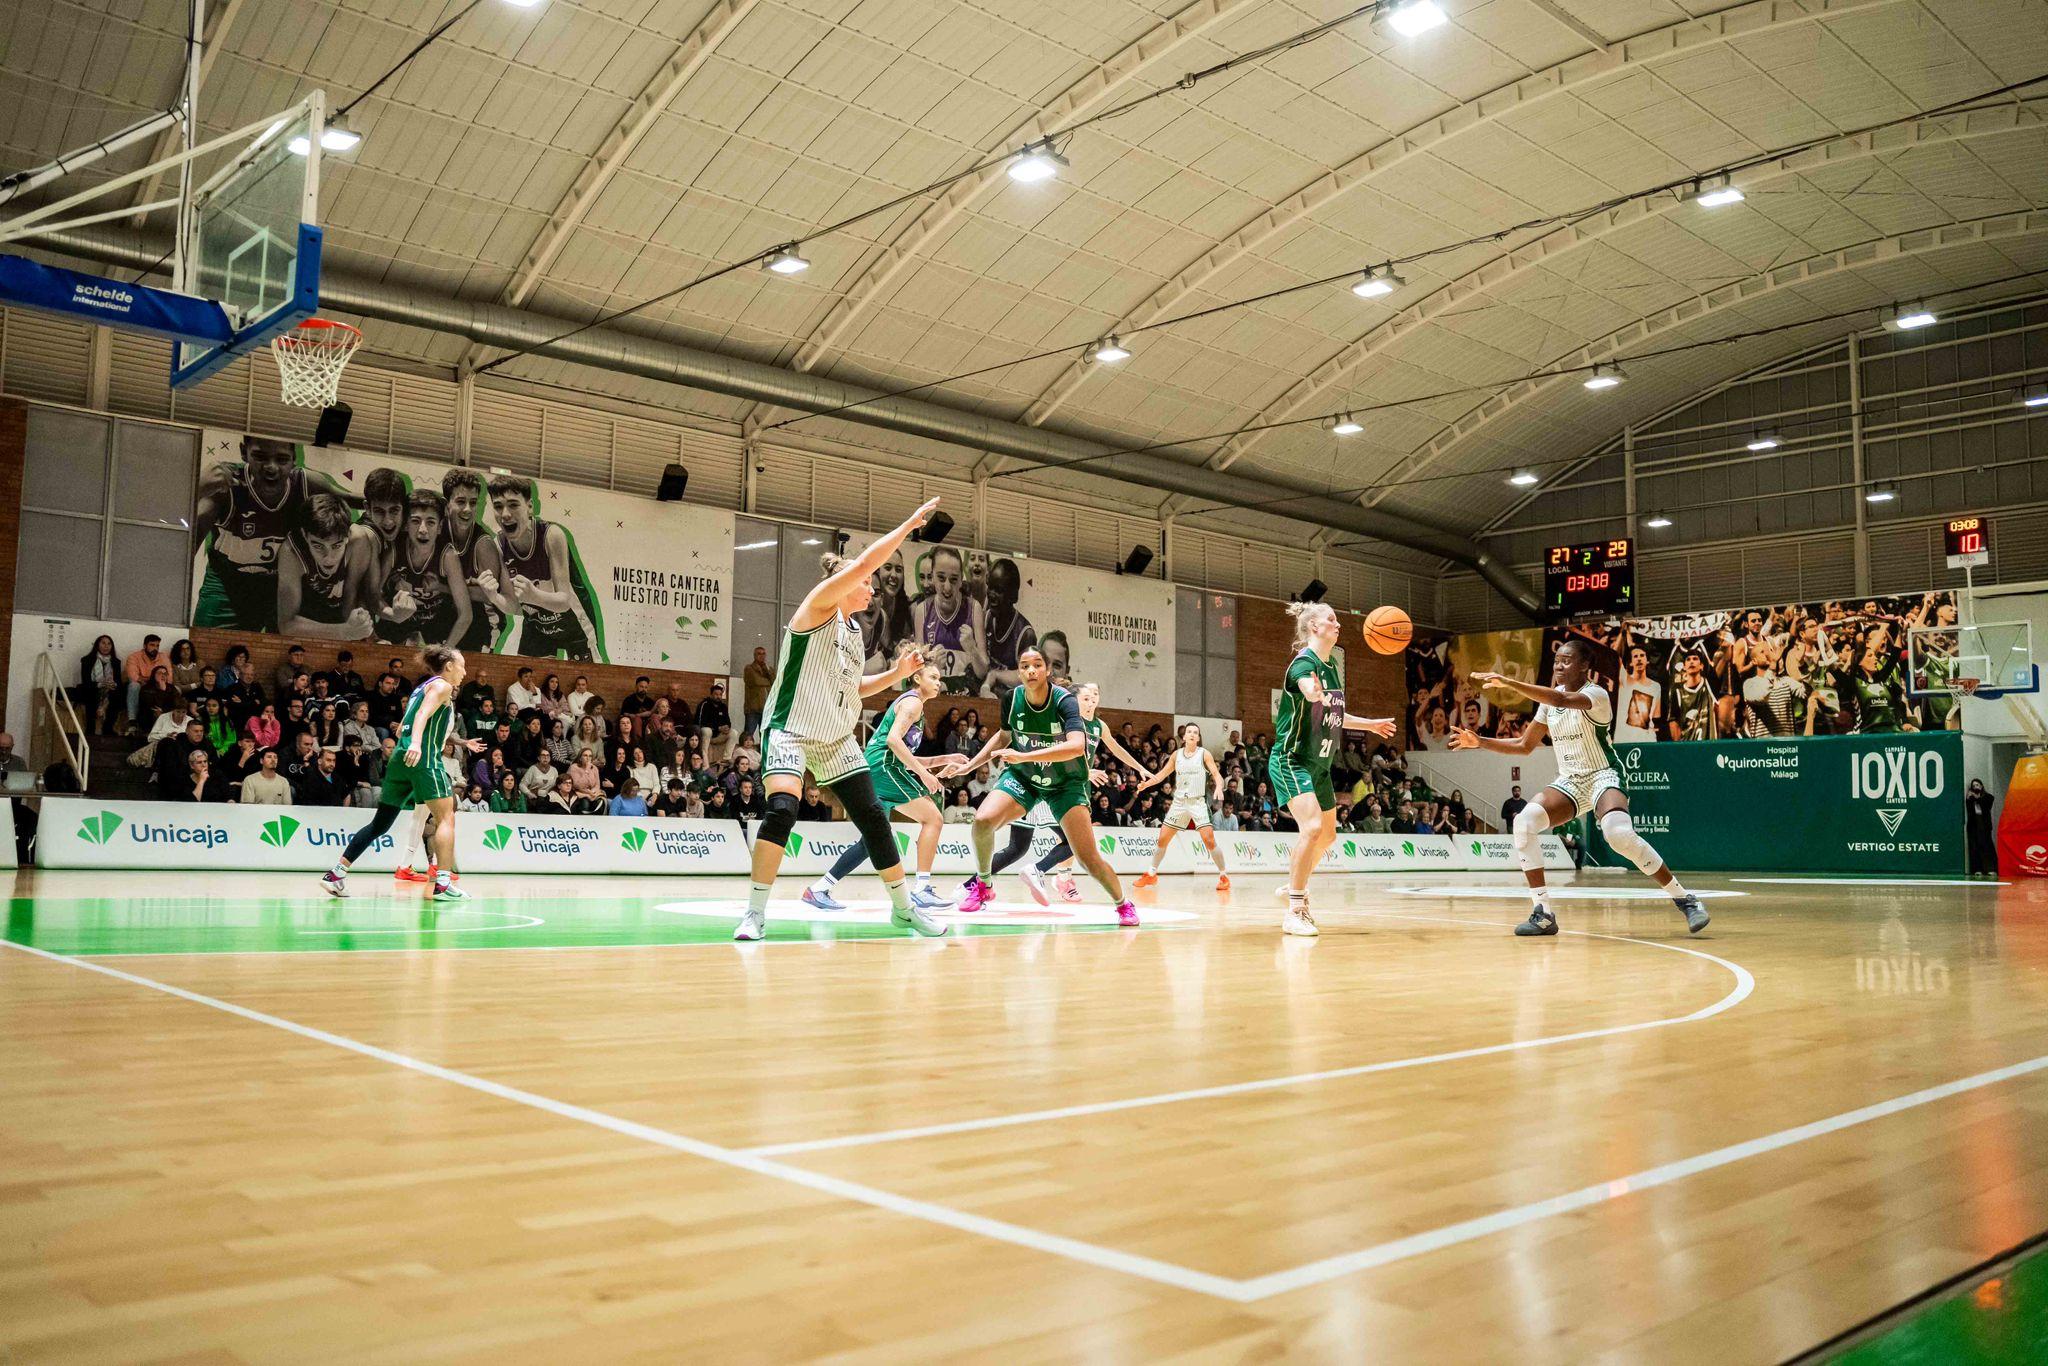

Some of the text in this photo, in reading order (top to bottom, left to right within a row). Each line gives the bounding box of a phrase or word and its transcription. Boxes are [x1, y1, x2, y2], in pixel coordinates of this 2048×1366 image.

[75, 284, 133, 303] schelde
[72, 294, 130, 312] international
[1608, 540, 1627, 557] 29
[1961, 533, 1979, 552] 10
[1551, 547, 1570, 564] 27
[1583, 552, 1591, 565] 2
[1603, 559, 1627, 568] VISITANTE
[1548, 566, 1570, 574] LOCAL
[613, 566, 720, 594] NUESTRA CANTERA
[1567, 573, 1609, 591] 03:08
[614, 584, 718, 612] NUESTRO FUTURO
[1558, 593, 1562, 604] 1
[1622, 586, 1630, 597] 4
[1088, 611, 1157, 632] NUESTRA CANTERA
[1089, 625, 1156, 646] NUESTRO FUTURO
[1319, 738, 1333, 757] 21
[1766, 745, 1798, 754] Hospital
[1629, 771, 1669, 782] GUERA
[1770, 771, 1798, 779] Málaga
[131, 823, 228, 849] Unicaja
[306, 828, 394, 852] Unija
[517, 826, 599, 840] Fundación
[652, 829, 726, 843] Fundación
[1118, 836, 1158, 846] Fundaci
[521, 840, 580, 857] Unicaja
[656, 842, 710, 858] Unicaja
[935, 841, 970, 859] icaja
[1233, 840, 1261, 860] Mijas
[1359, 846, 1395, 860] Unicaja
[1416, 846, 1450, 860] Unicaja
[1847, 842, 1940, 852] VERTIGO ESTATE
